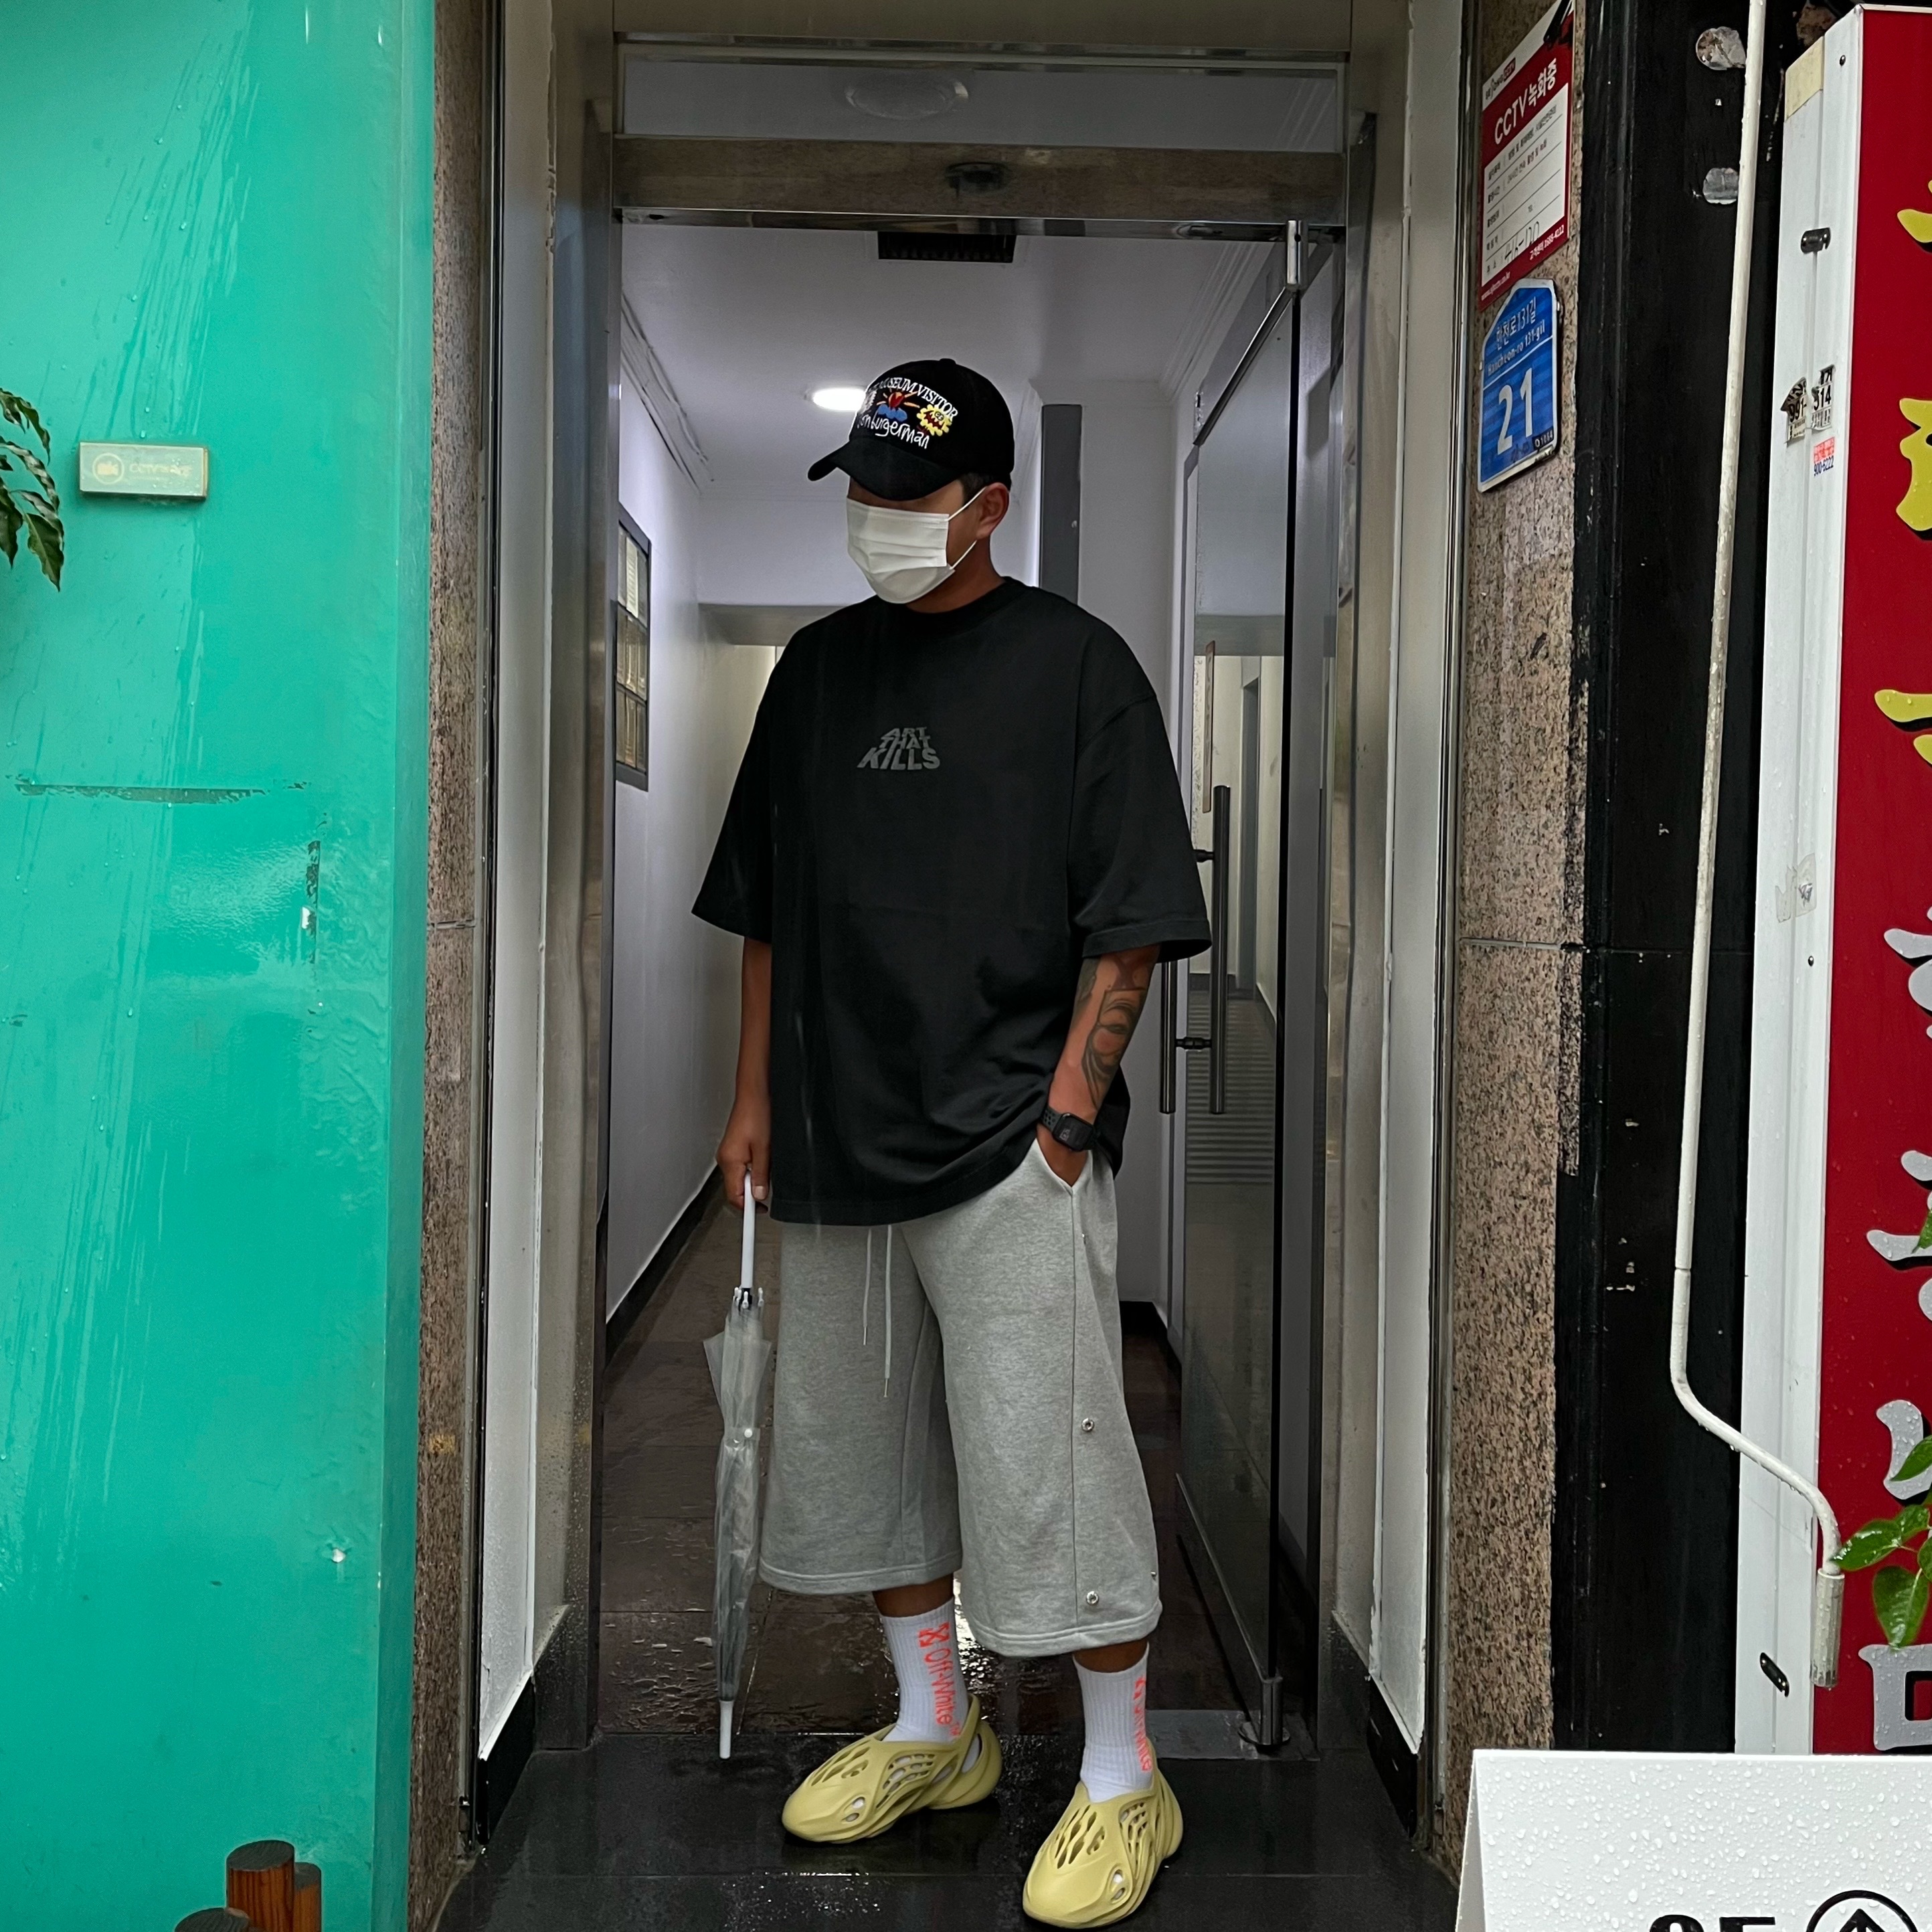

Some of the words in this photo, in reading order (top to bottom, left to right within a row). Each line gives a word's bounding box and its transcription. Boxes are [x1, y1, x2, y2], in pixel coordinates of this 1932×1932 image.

[916, 382, 958, 422] VISITOR
[1497, 367, 1534, 455] 21
[879, 735, 931, 750] THAT
[883, 727, 928, 738] ART
[857, 747, 940, 770] KILLS
